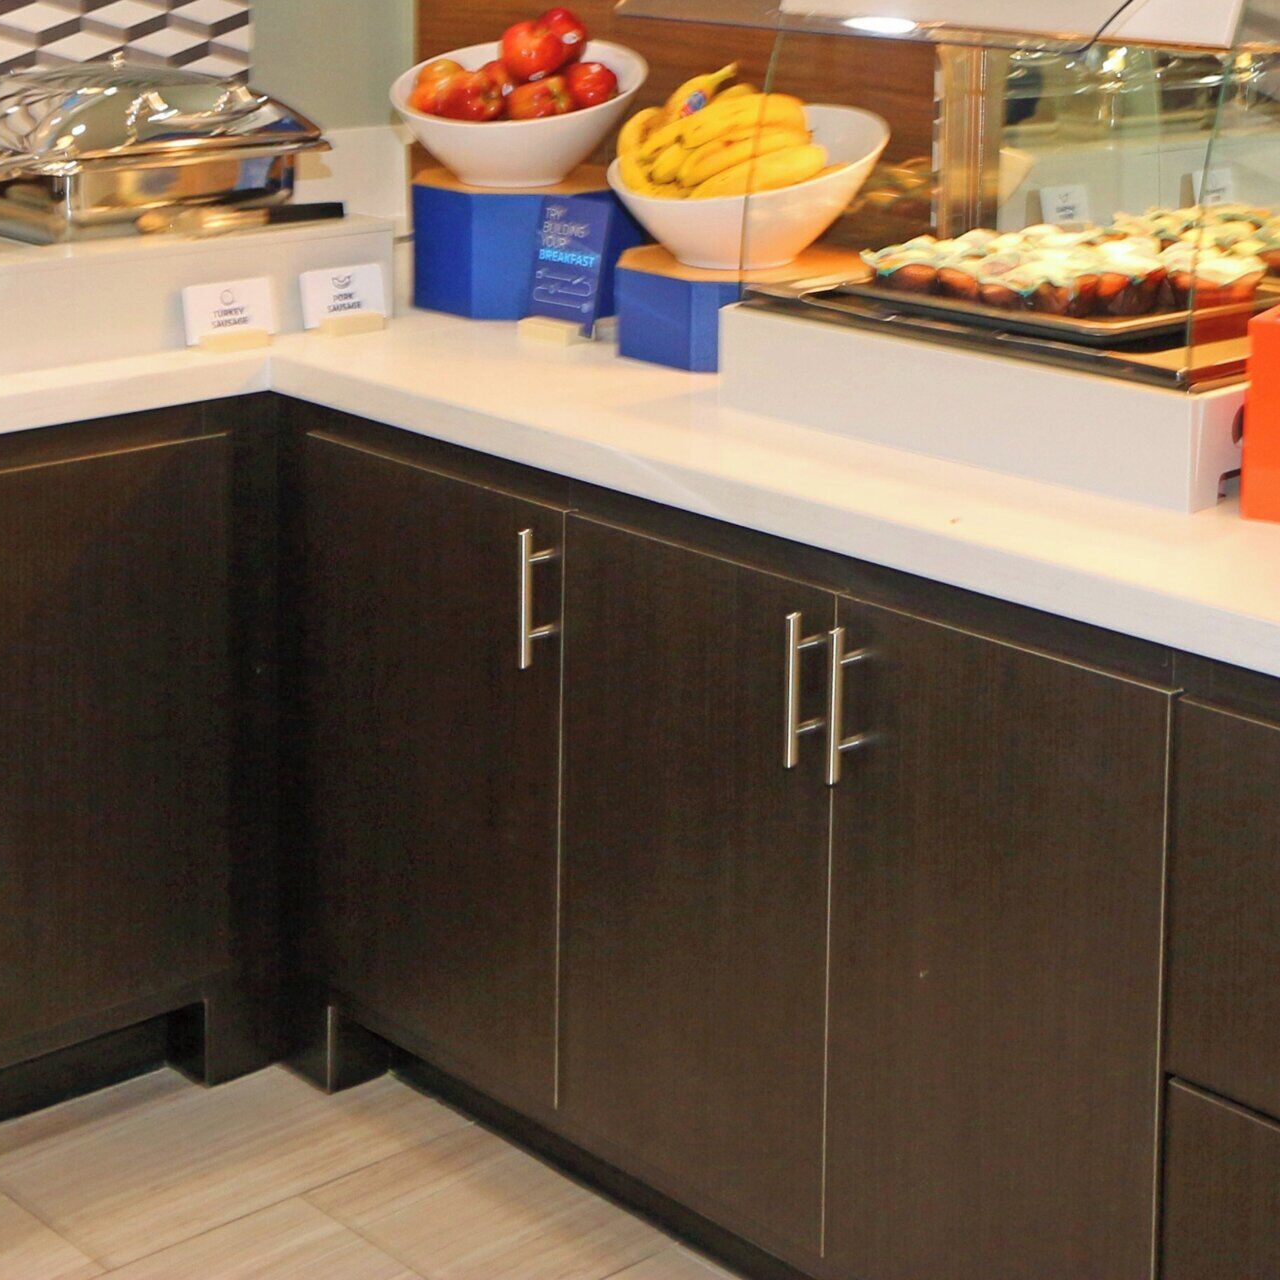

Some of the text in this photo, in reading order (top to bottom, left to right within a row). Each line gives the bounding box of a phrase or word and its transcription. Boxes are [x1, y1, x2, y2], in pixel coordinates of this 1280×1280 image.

[545, 207, 565, 221] TRY
[538, 248, 596, 269] BREAKFAST
[213, 307, 245, 319] TURKEY
[327, 301, 362, 313] SAUSAGE
[211, 317, 249, 329] SAUSAGE
